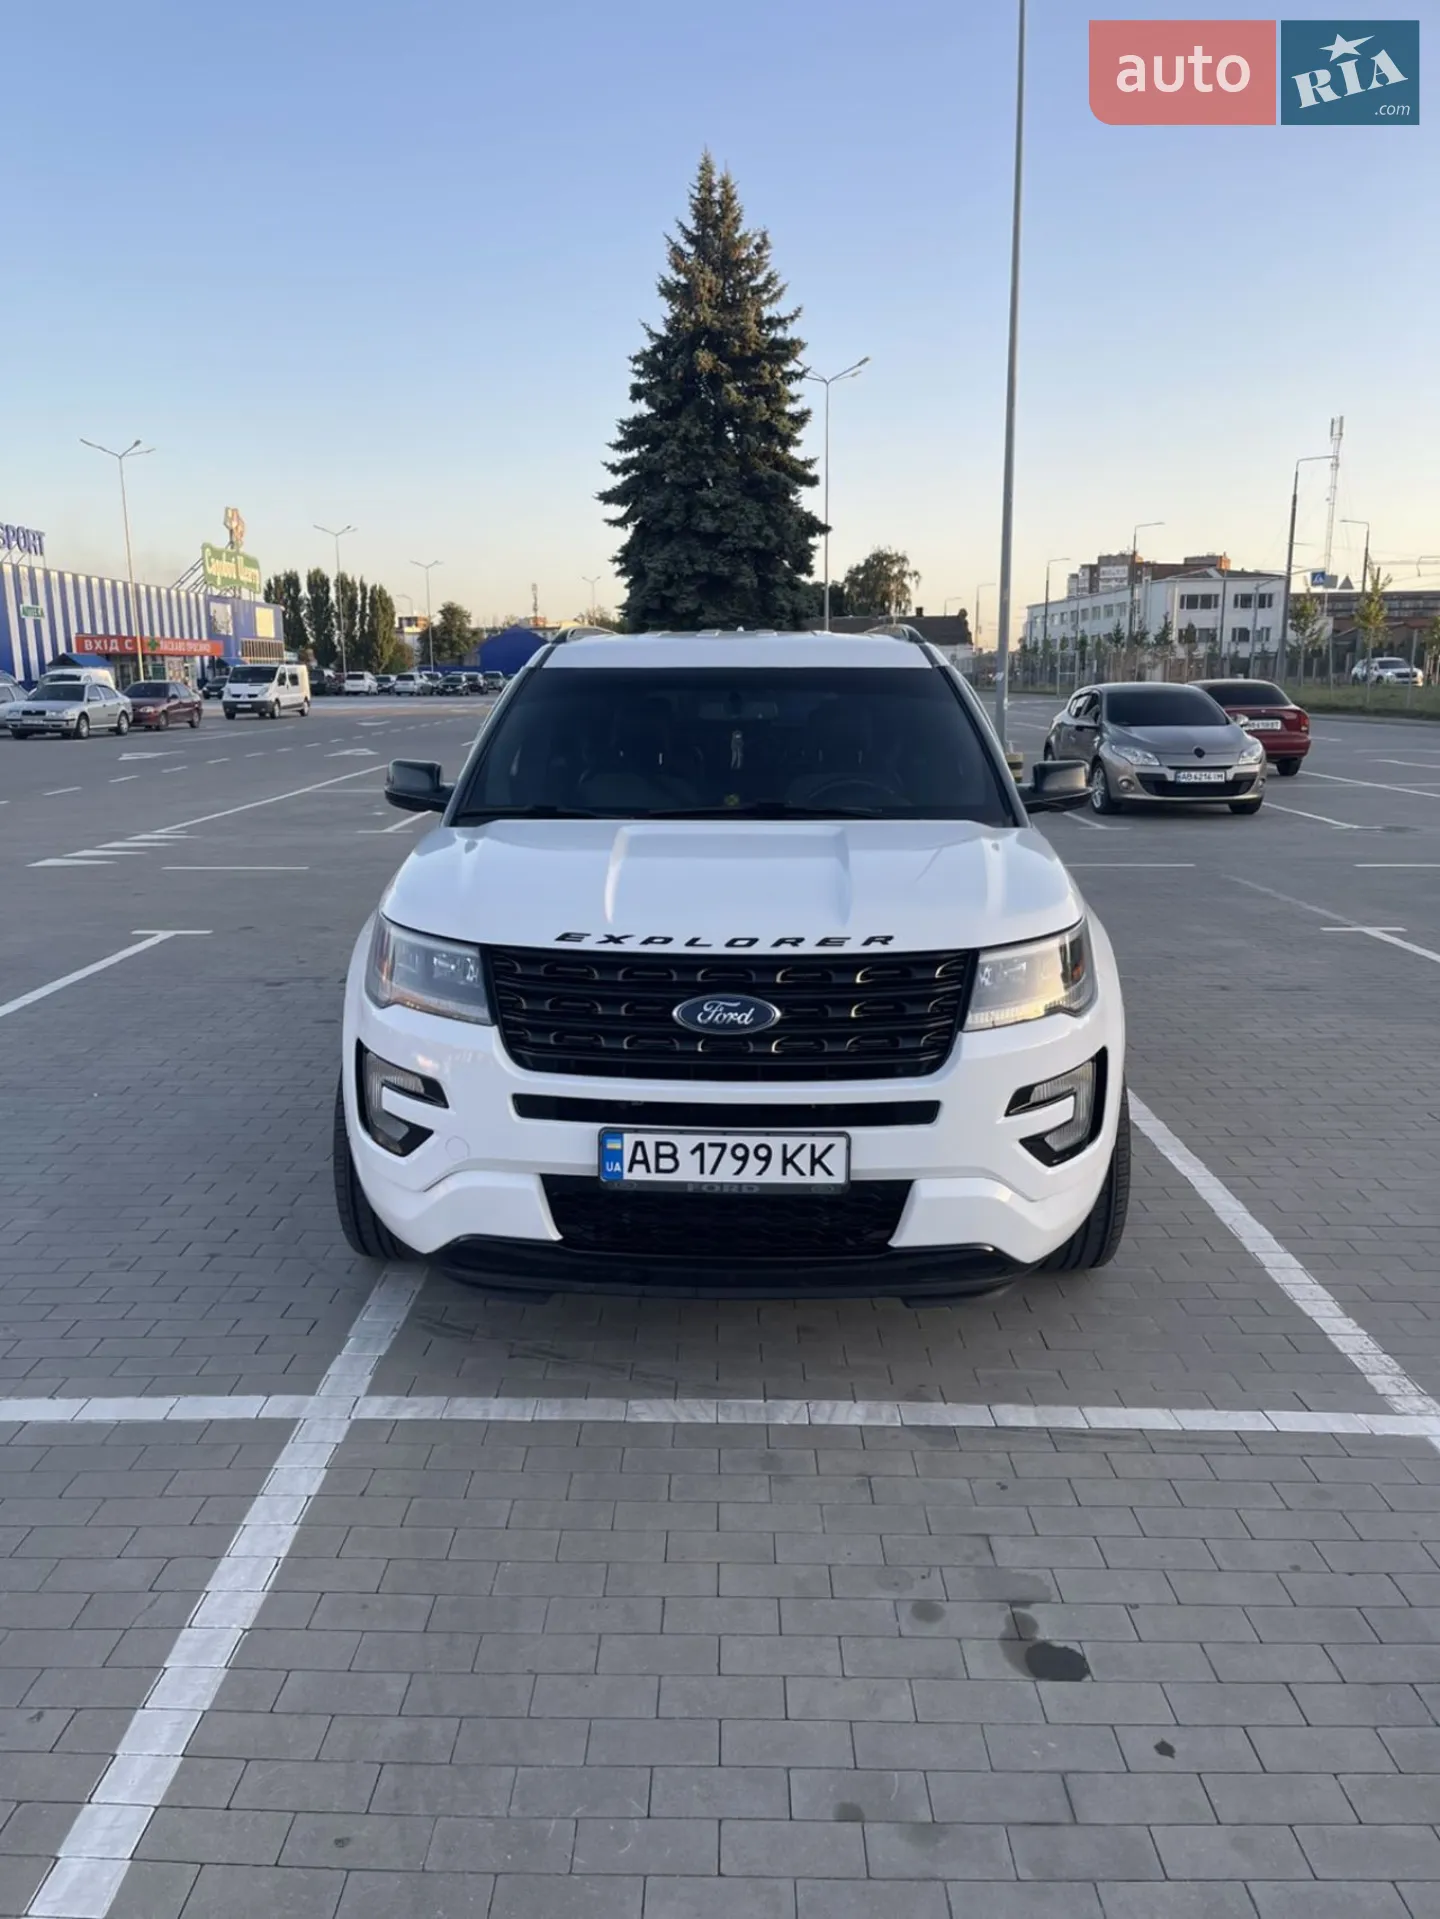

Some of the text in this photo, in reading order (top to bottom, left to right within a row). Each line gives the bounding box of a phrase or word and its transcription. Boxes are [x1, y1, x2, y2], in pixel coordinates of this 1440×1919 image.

[554, 932, 895, 948] EXPLORER
[697, 1000, 754, 1026] Ford
[605, 1161, 622, 1172] UA
[627, 1140, 836, 1177] AB 1799 KK
[687, 1183, 760, 1193] FORD
